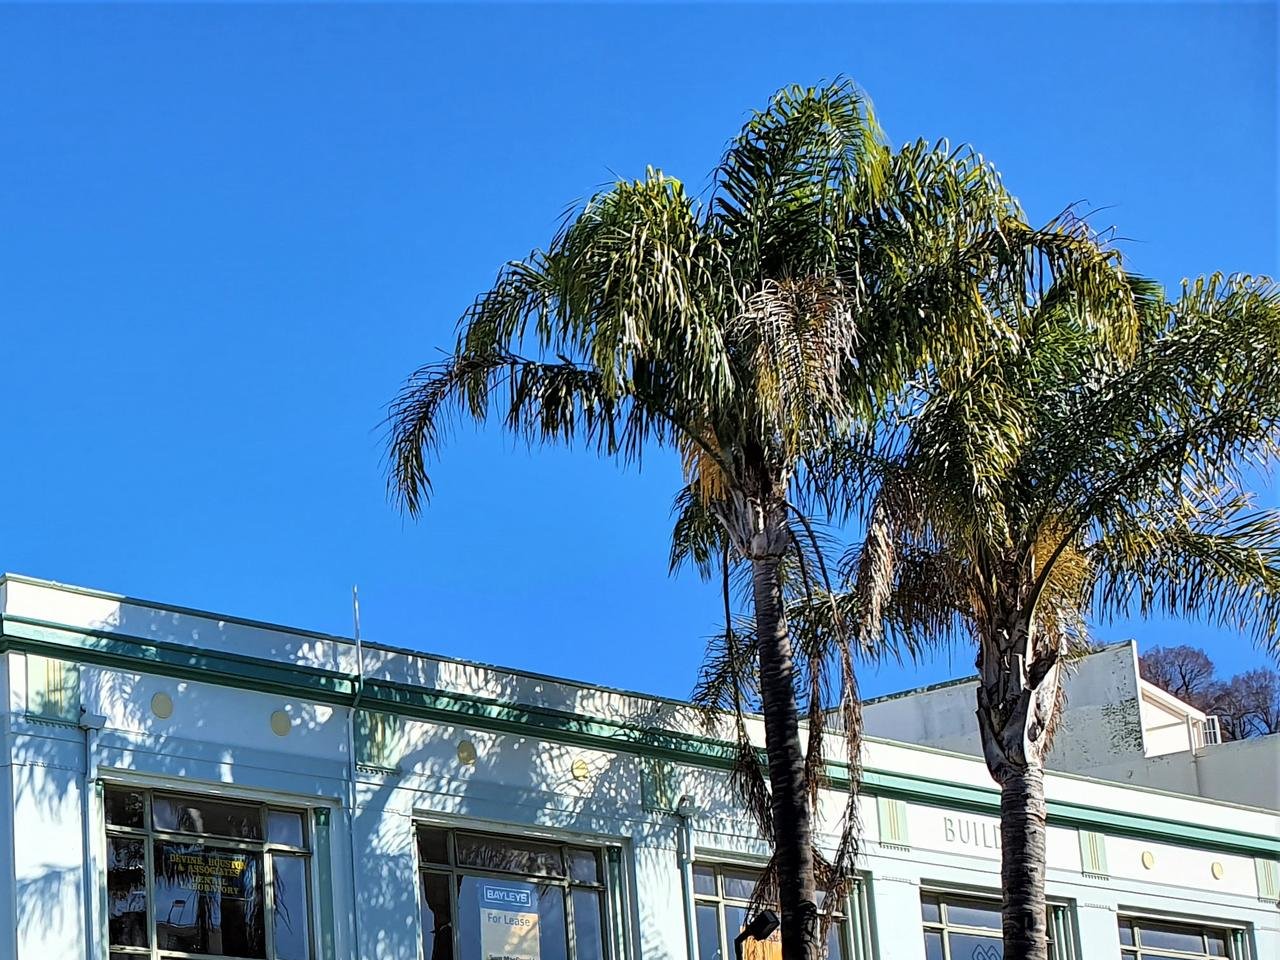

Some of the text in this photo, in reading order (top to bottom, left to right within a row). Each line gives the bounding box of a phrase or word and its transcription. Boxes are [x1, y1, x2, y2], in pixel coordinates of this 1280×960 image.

[943, 817, 1001, 849] BUILD
[486, 889, 528, 902] BAYLEYS
[487, 913, 531, 927] For Lease
